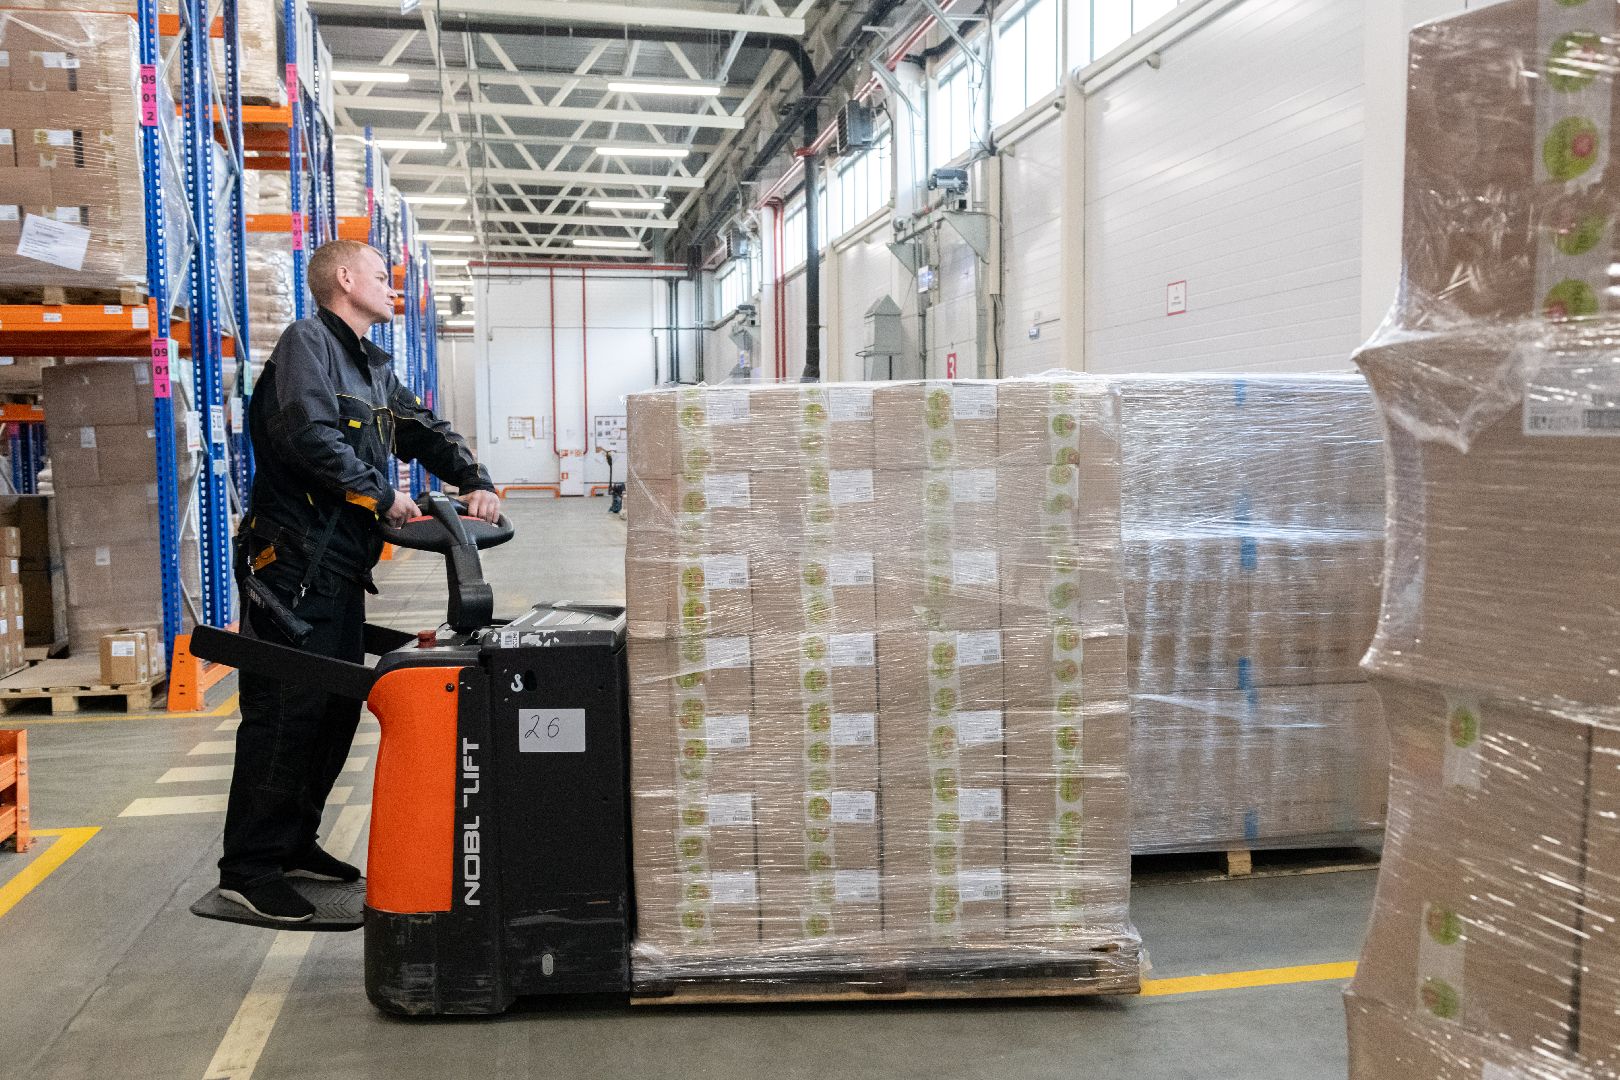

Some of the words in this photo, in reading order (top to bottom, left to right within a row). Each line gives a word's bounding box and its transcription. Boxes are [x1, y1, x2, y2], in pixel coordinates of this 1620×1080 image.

[141, 75, 156, 84] 09
[142, 94, 157, 102] 01
[146, 112, 154, 121] 2
[154, 348, 168, 357] 09
[155, 366, 169, 375] 01
[160, 383, 166, 392] 1
[462, 737, 481, 906] NOBLLIFT
